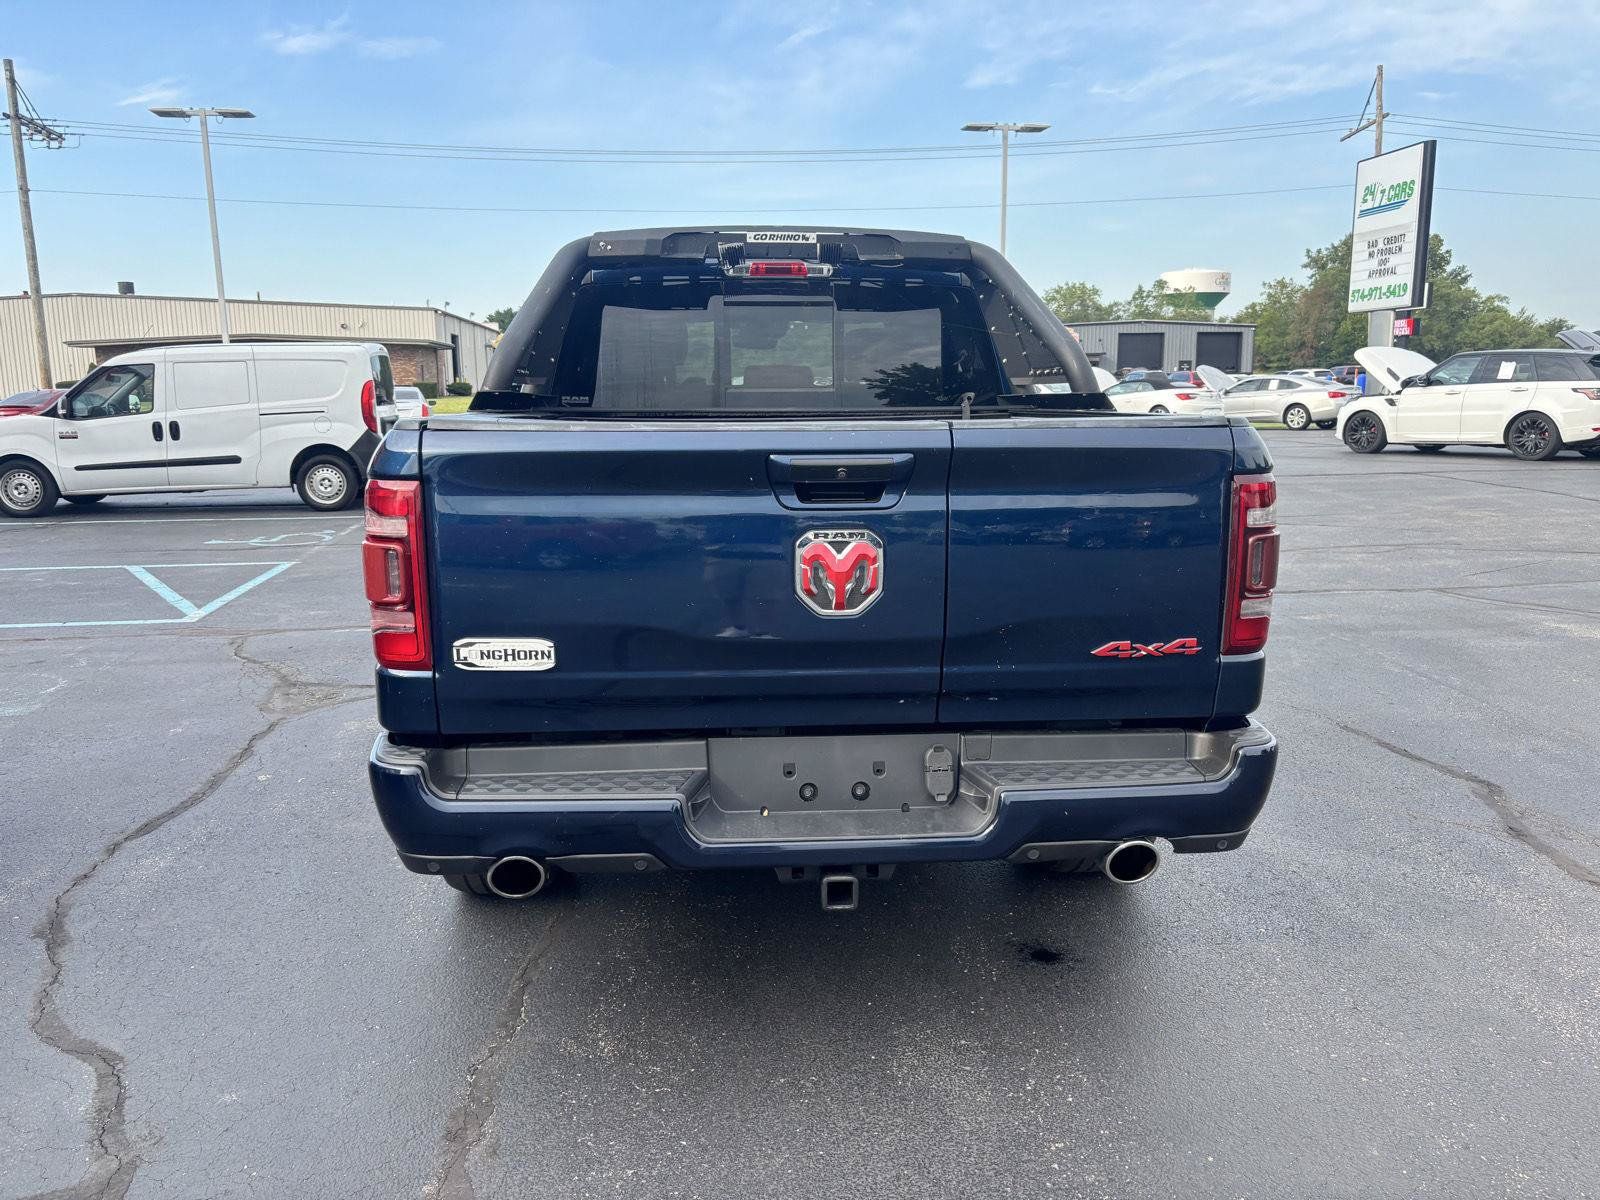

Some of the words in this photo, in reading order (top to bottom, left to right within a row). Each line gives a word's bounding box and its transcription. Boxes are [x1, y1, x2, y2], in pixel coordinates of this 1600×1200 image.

[1386, 180, 1416, 202] CARS
[1367, 239, 1379, 249] BAD
[1383, 233, 1406, 246] CREDIT?
[1368, 250, 1375, 259] NO
[1376, 244, 1403, 257] PROBLEM
[1367, 266, 1397, 279] APPROVAL
[813, 532, 866, 540] RAM
[1090, 637, 1203, 658] 4x4
